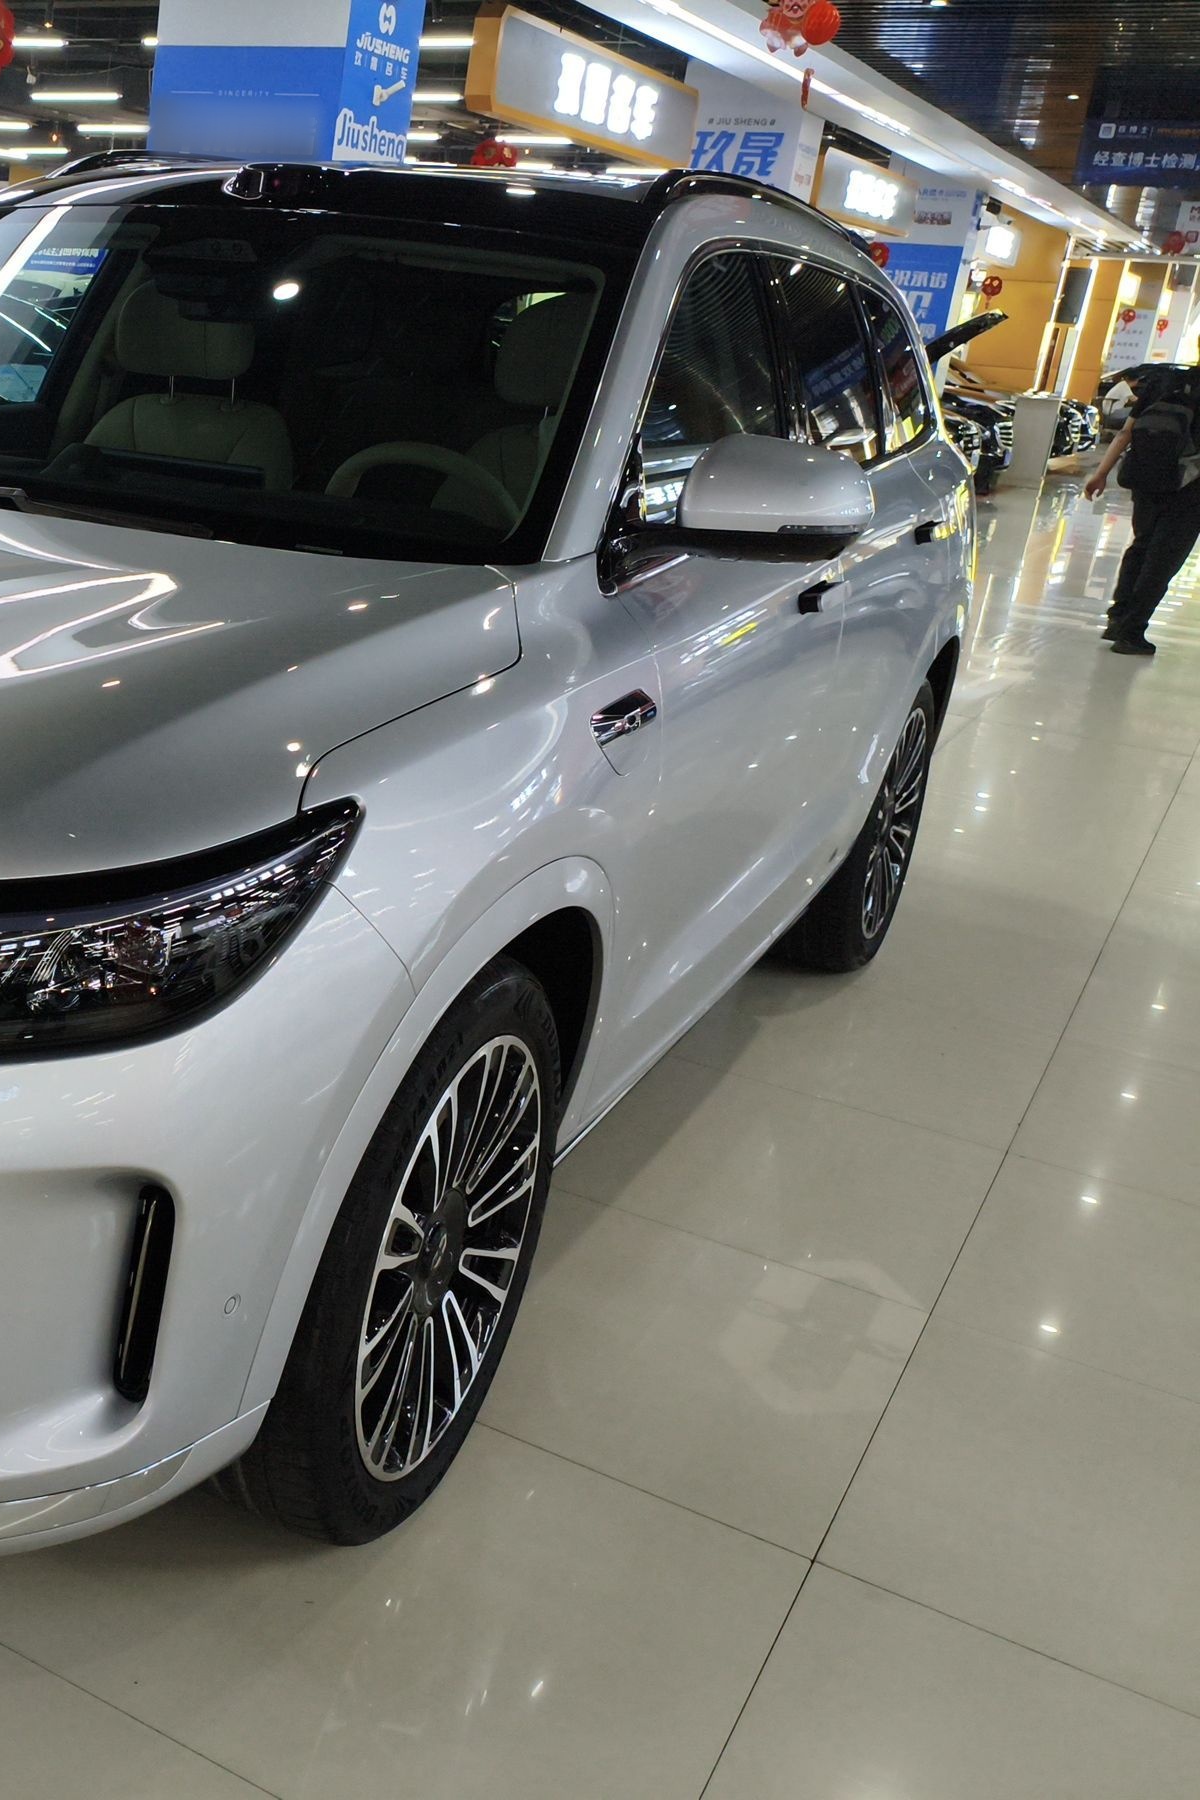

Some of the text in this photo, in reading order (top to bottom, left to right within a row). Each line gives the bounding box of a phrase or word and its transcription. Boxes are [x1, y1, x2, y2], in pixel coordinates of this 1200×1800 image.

[716, 117, 768, 126] JIU SHENG
[690, 130, 785, 176] 玖晟
